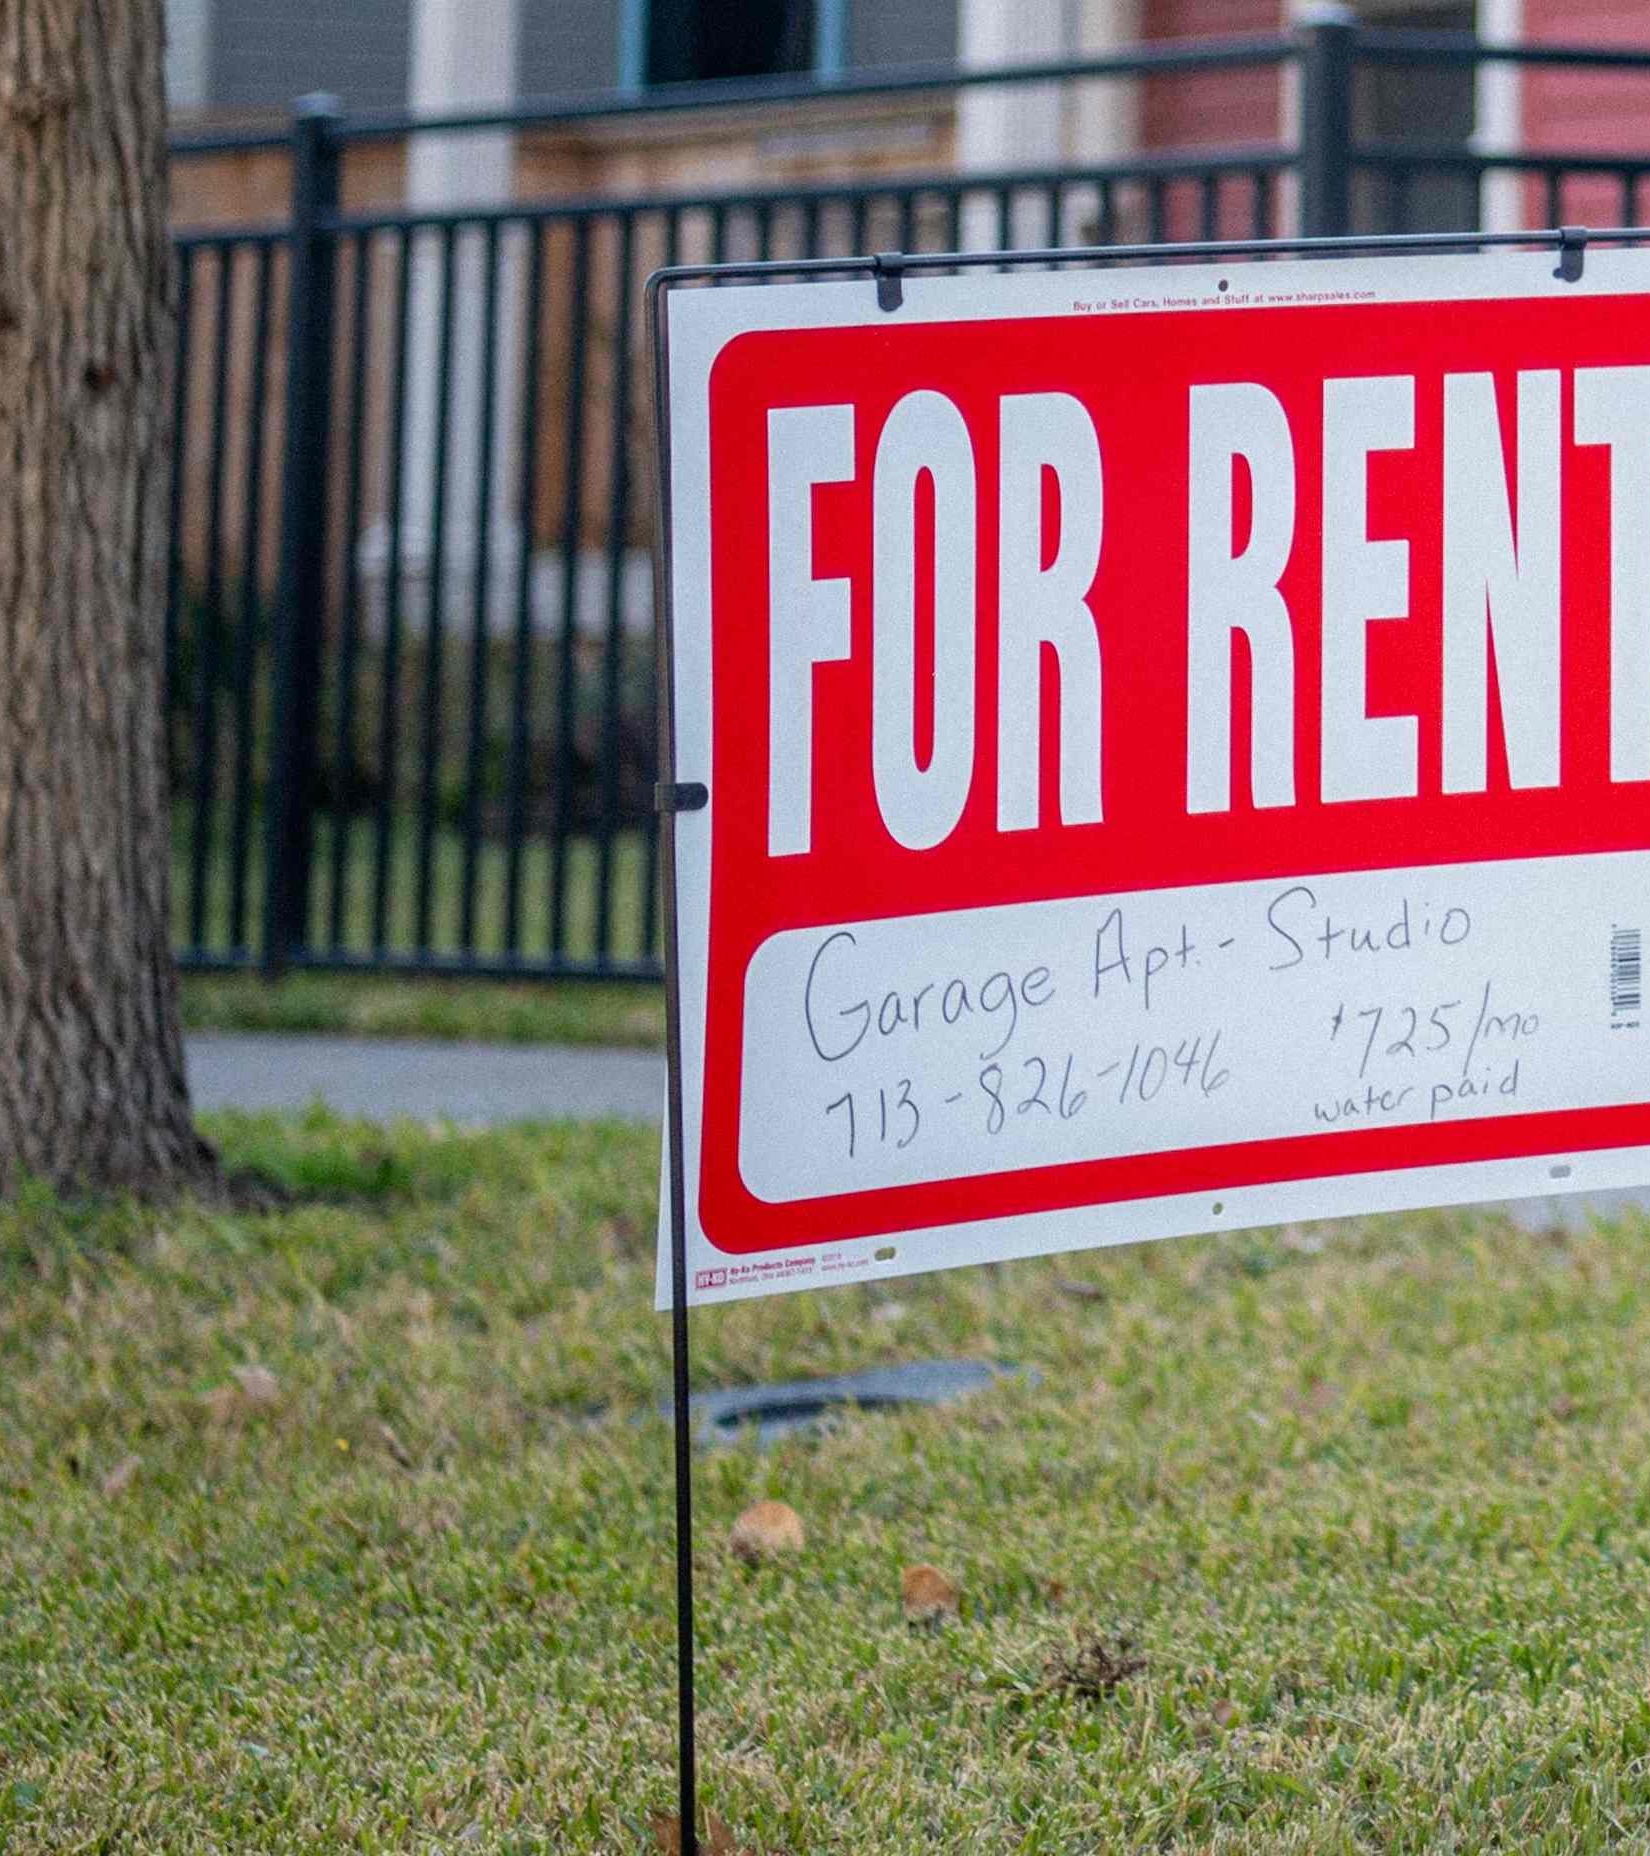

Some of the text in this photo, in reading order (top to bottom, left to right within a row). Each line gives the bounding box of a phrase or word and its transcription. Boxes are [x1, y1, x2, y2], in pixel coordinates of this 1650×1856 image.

[1073, 300, 1091, 312] Buy
[1096, 301, 1107, 310] or
[1111, 298, 1130, 310] Sell
[1163, 295, 1197, 307] Homes
[1201, 294, 1221, 305] and
[1224, 293, 1249, 305] Stuff
[1254, 293, 1264, 303] at
[767, 389, 1104, 857] FOR
[805, 931, 1055, 1062] Garage
[1267, 886, 1472, 971] Studio
[826, 1030, 1230, 1158] 713-826-1046
[1314, 1058, 1520, 1123] water paid
